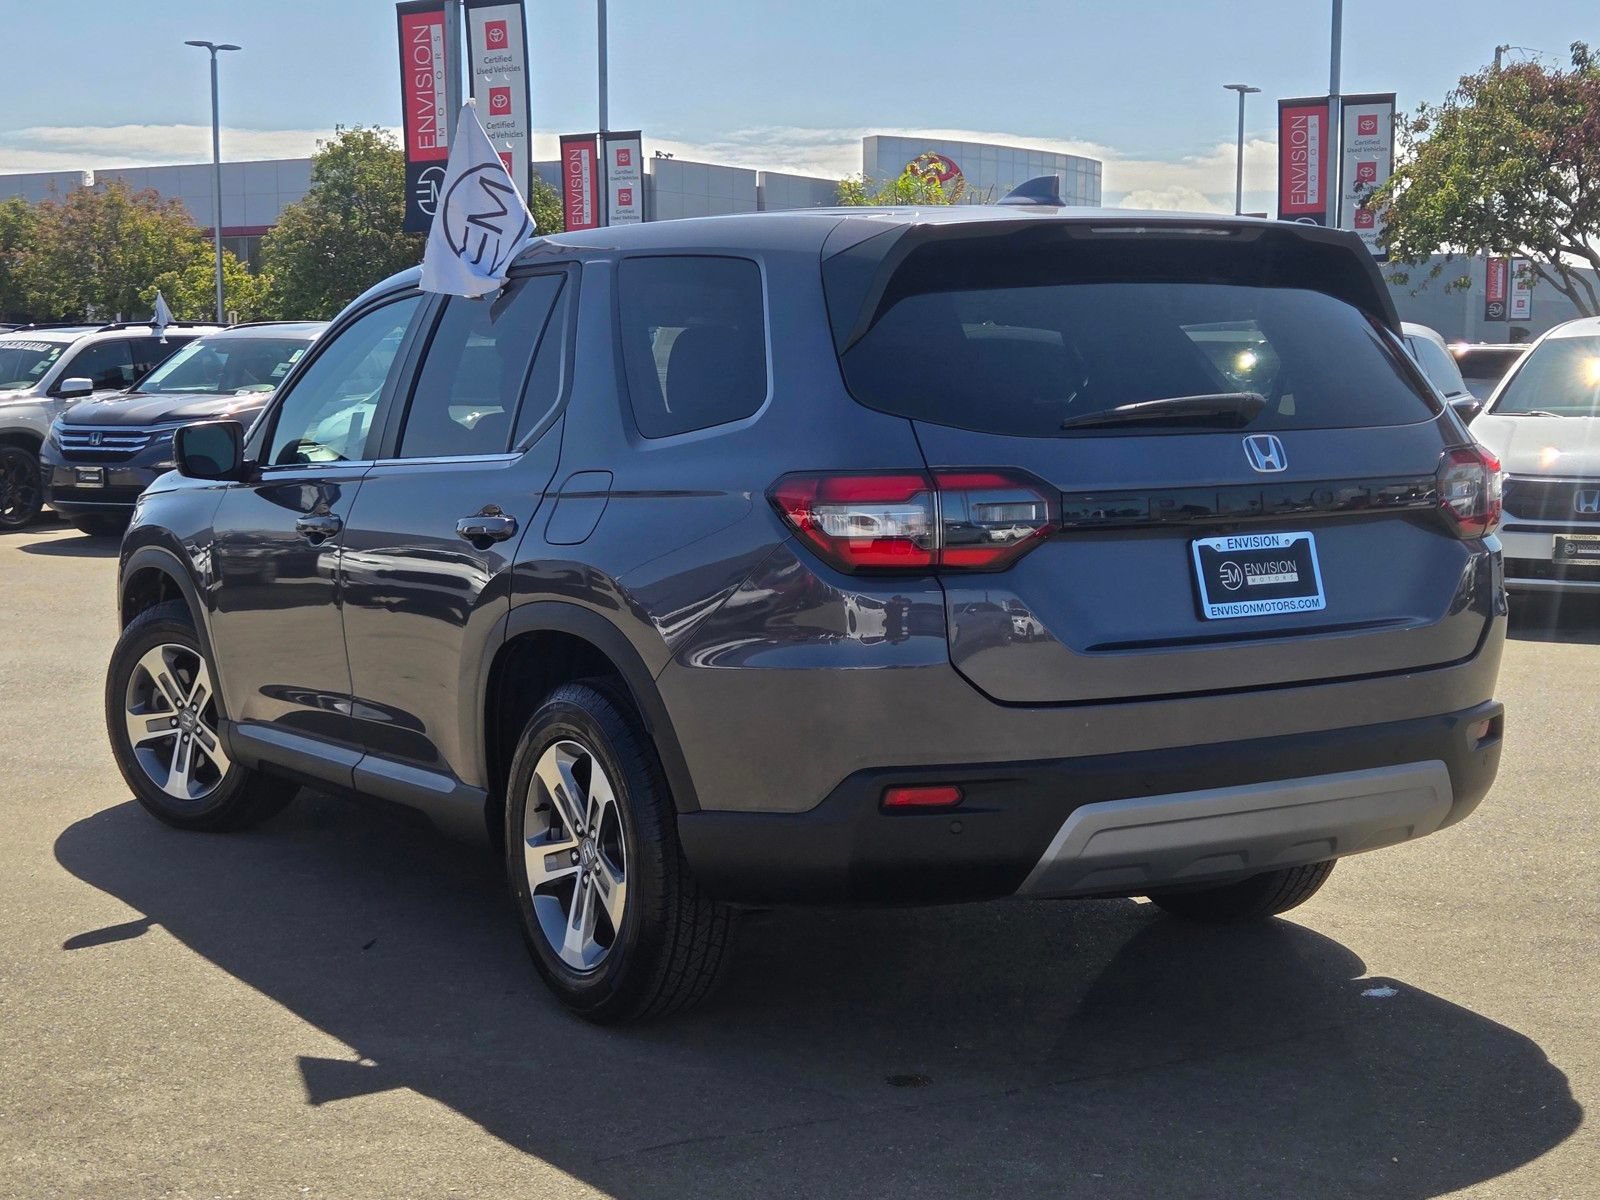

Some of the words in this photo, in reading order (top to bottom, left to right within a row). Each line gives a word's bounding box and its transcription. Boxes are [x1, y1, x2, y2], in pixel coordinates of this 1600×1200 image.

[484, 55, 513, 65] Certified
[476, 67, 493, 75] Used
[494, 66, 521, 74] Vehicles
[412, 25, 436, 149] ENVISION
[434, 36, 445, 137] MOTORS
[486, 121, 515, 130] Certified
[496, 131, 524, 139] Vehicles
[1291, 115, 1307, 205] ENVISION
[569, 149, 583, 225] ENVISION
[1227, 535, 1280, 549] ENVISION
[1244, 560, 1297, 576] ENVISION
[1251, 574, 1295, 583] MOTORS
[1211, 598, 1320, 616] ENVISIONMOTORS.COM
